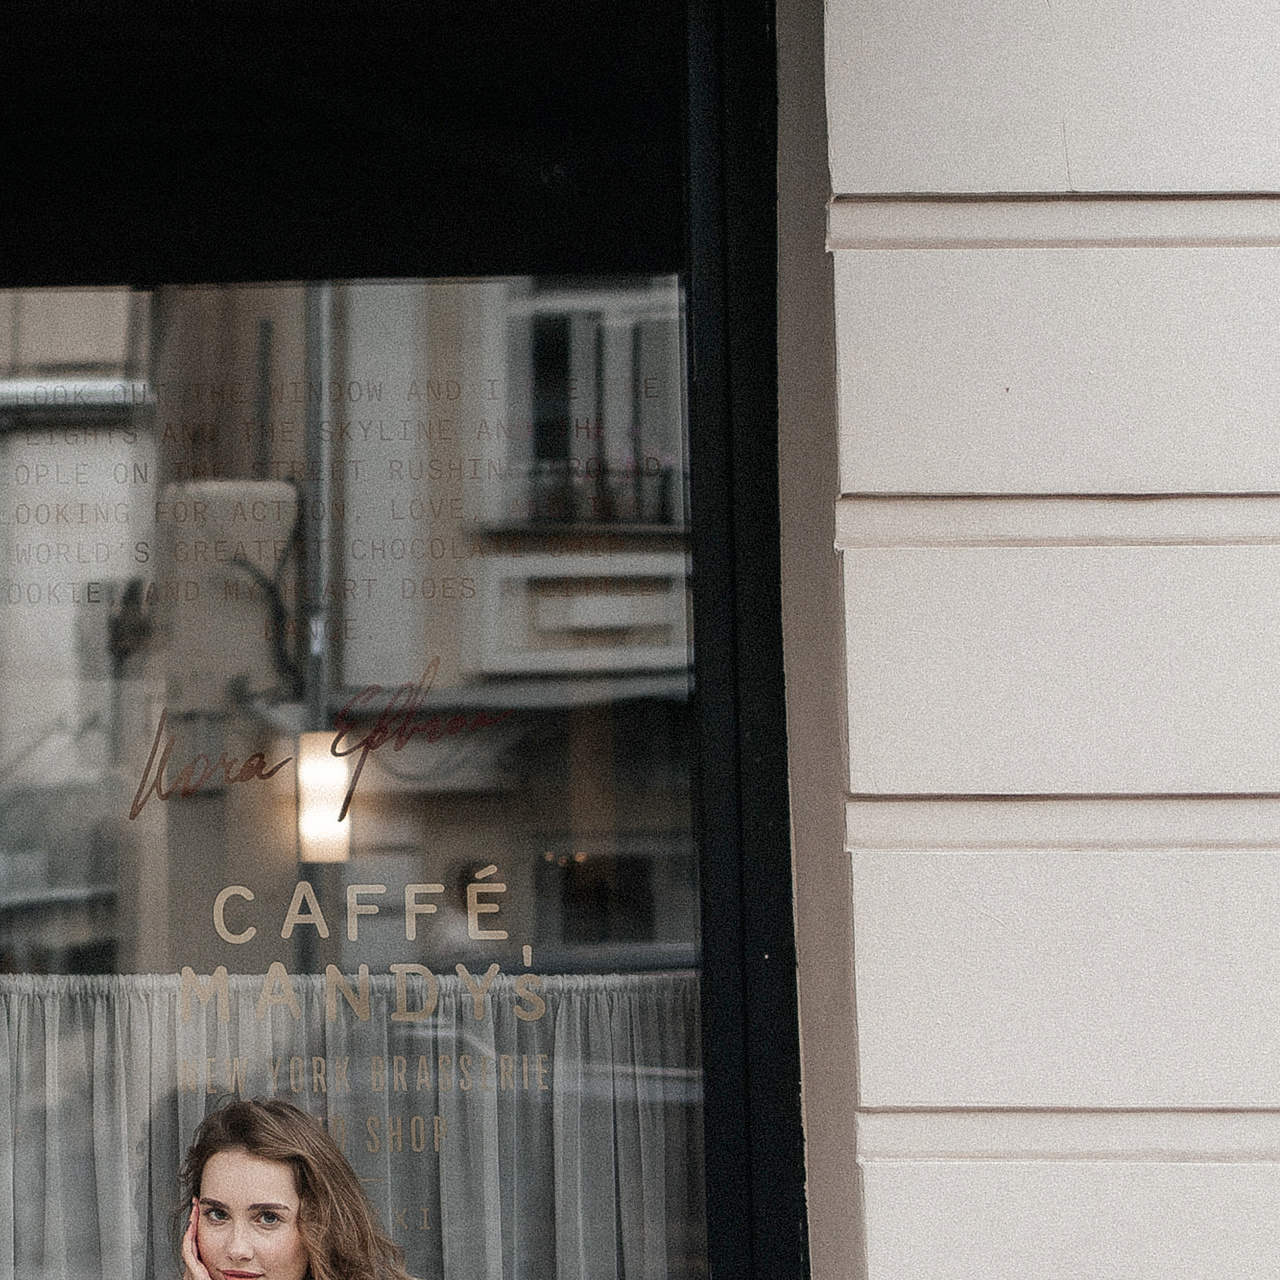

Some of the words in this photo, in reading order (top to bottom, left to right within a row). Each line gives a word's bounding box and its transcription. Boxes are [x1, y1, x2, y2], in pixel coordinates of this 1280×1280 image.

[16, 383, 89, 406] LOOK
[111, 382, 166, 405] OUT
[269, 380, 384, 404] WINDOW
[406, 379, 462, 402] AND
[486, 379, 499, 401] I
[25, 423, 138, 446] LIGHTS
[161, 422, 218, 445] AND
[242, 421, 295, 443] THE
[319, 419, 454, 442] SKYLINE
[112, 462, 150, 485] ON
[252, 460, 366, 482] STREET
[155, 501, 210, 524] FOR
[232, 500, 363, 523] ACTION,
[390, 498, 481, 523] LOVE,
[15, 540, 151, 565] WORLD'S
[351, 536, 526, 562] CHOCOLATE
[145, 580, 201, 603] AND
[222, 579, 260, 602] MY
[401, 576, 476, 600] DOES
[213, 863, 509, 945] CAFFÉ
[179, 1055, 249, 1095] NEW
[267, 1055, 352, 1094] YORK
[370, 1053, 551, 1093] BRASSERIE
[366, 1114, 449, 1154] SHOP
